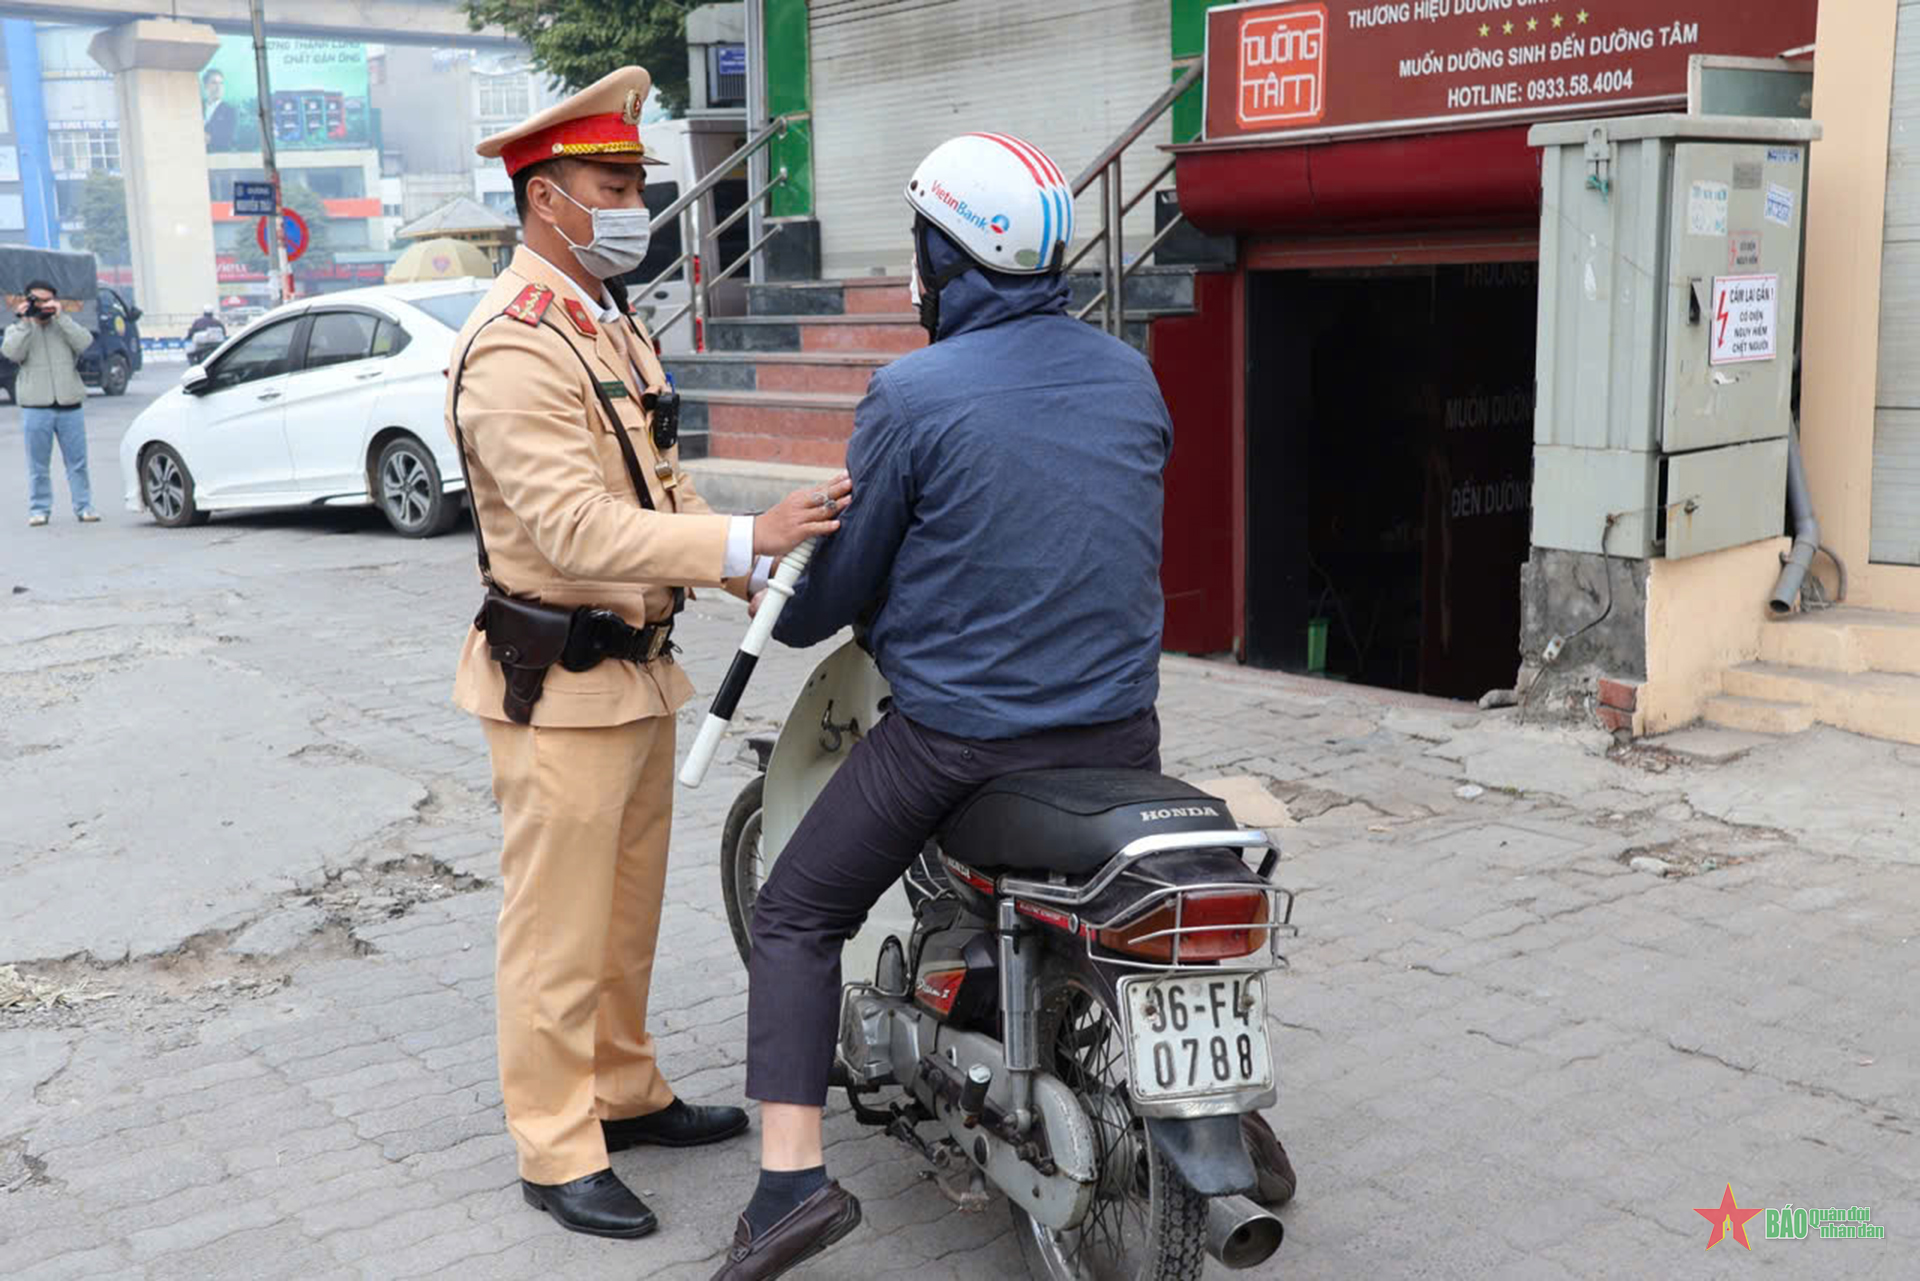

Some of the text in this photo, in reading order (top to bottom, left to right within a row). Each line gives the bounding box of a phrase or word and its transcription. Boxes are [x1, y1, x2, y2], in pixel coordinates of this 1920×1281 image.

[1348, 4, 1410, 29] THƯƠNG
[1399, 21, 1699, 77] MUỐN DƯỠNG SINH ĐẾN DƯỠNG TÂM
[1448, 68, 1633, 108] HOTLINE: 0933.58.4004
[931, 179, 988, 231] VietinBank
[1140, 806, 1219, 821] HONDA
[1153, 1033, 1253, 1088] 0788
